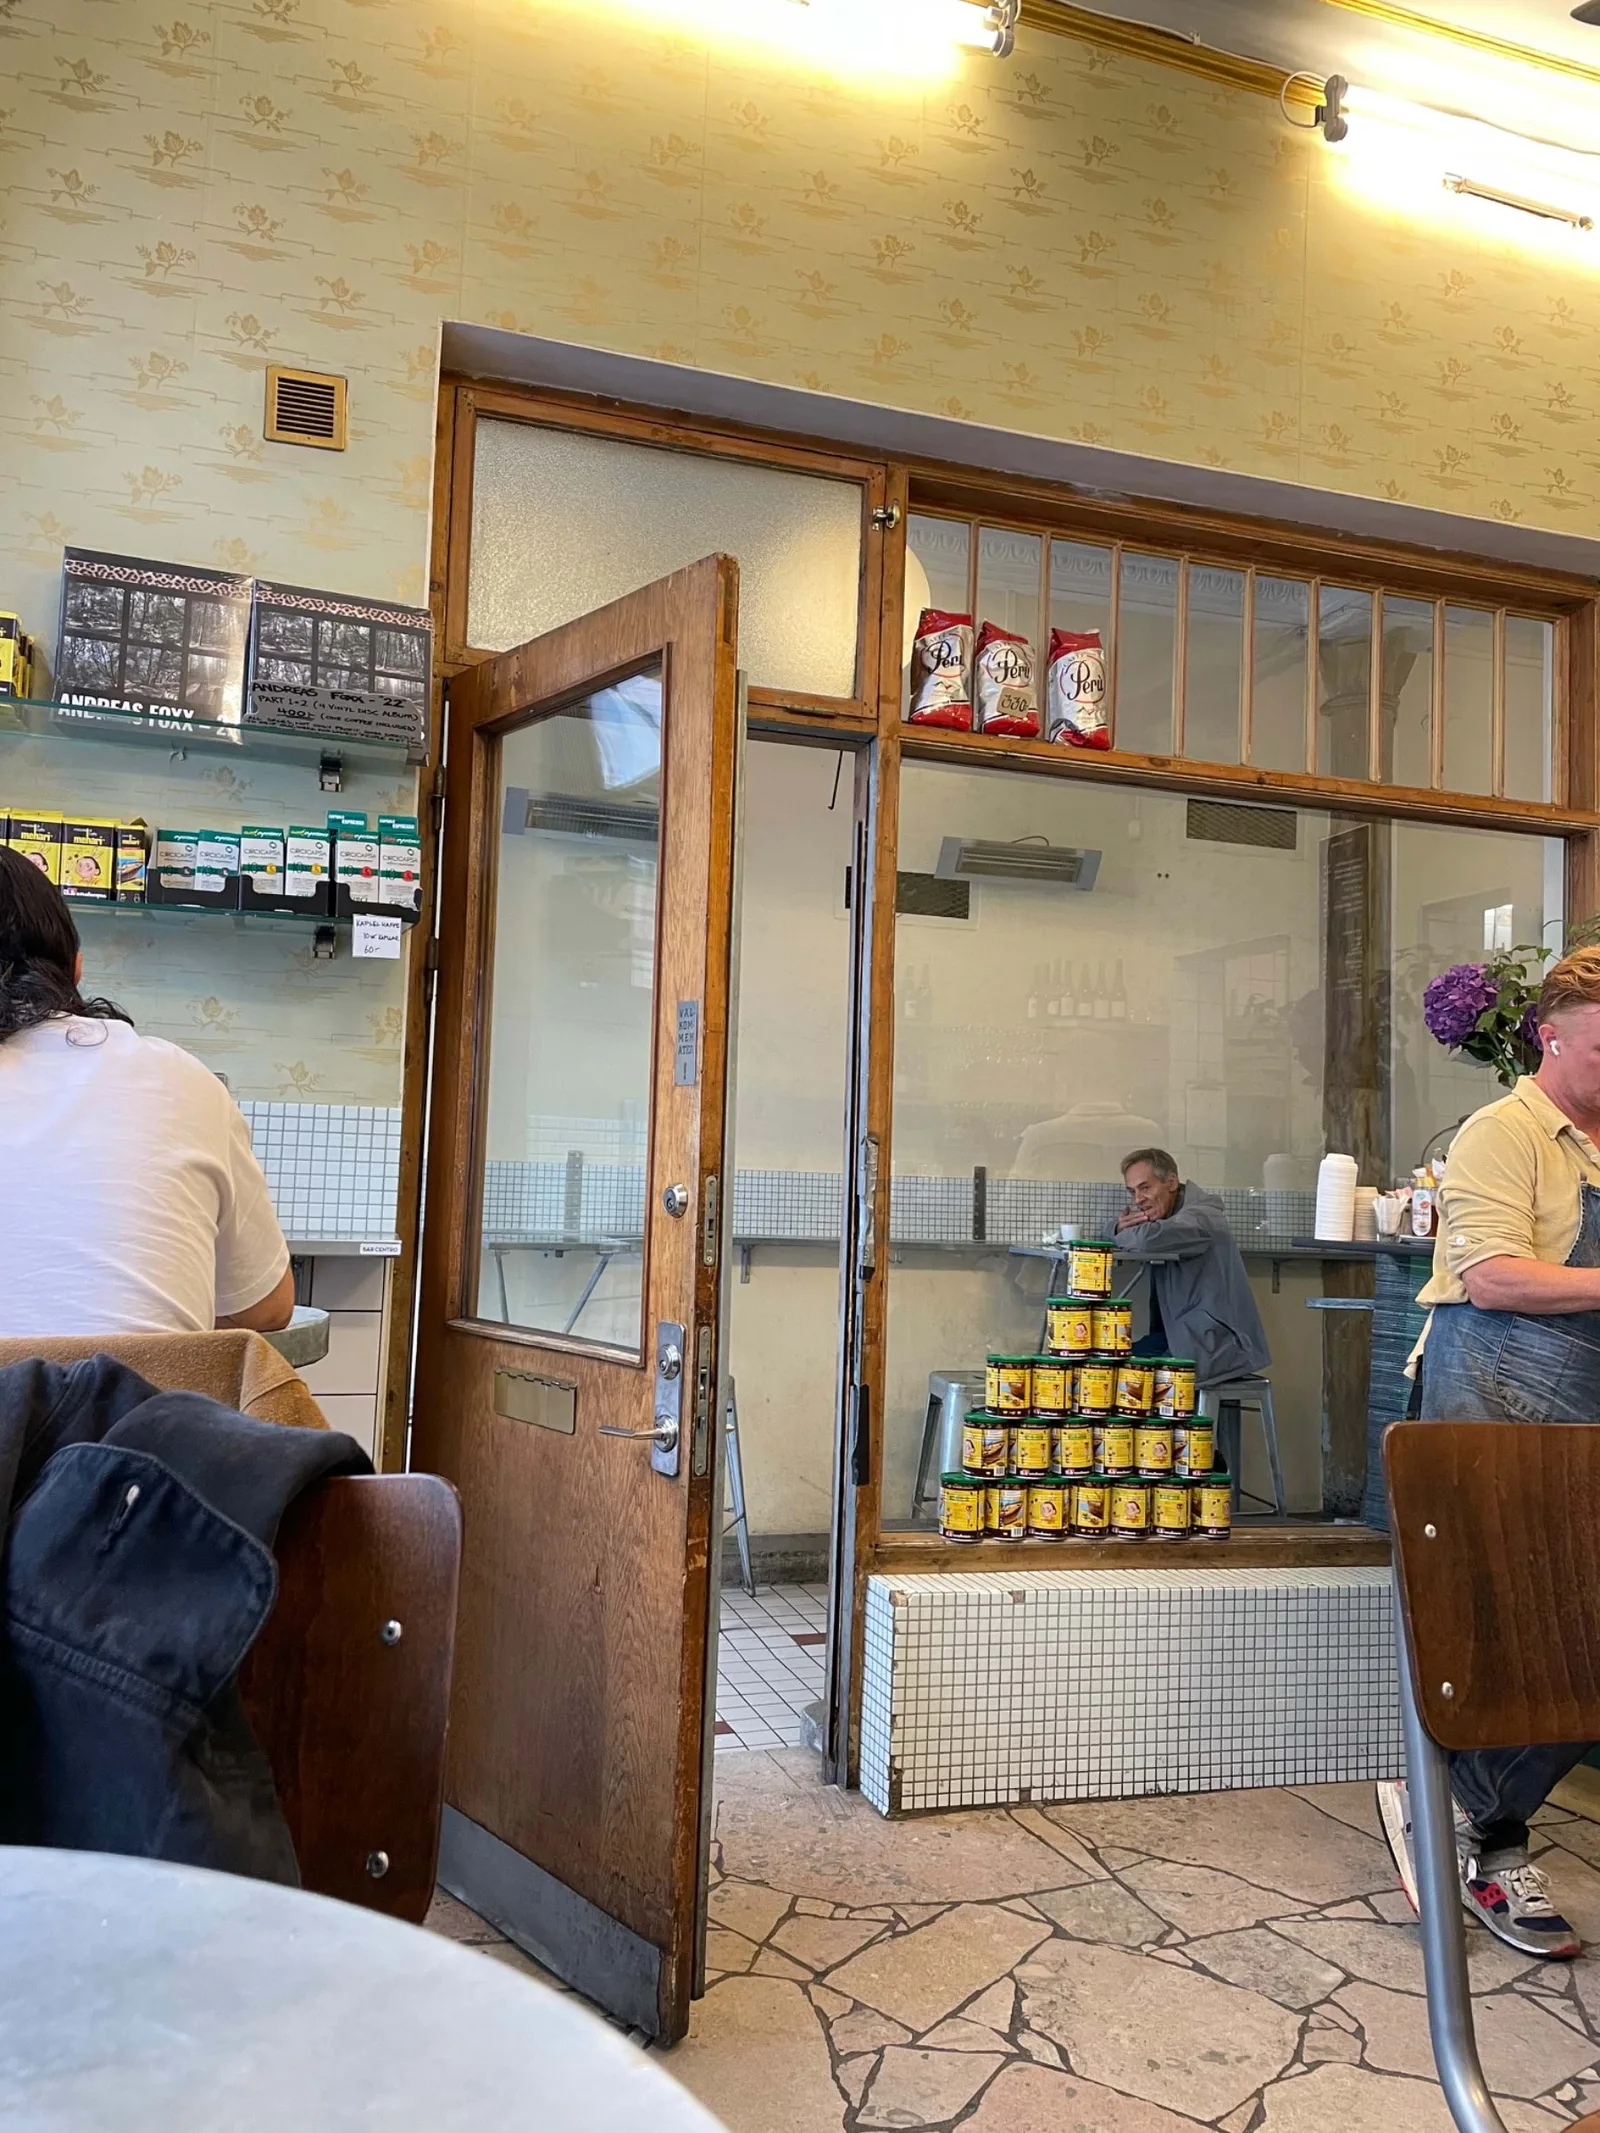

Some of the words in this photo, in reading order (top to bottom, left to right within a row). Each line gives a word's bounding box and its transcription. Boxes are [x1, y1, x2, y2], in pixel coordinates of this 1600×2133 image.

[252, 681, 318, 697] ANDREAS
[1065, 660, 1103, 700] Perù
[258, 695, 285, 704] PART
[382, 711, 419, 722] ALBUM)
